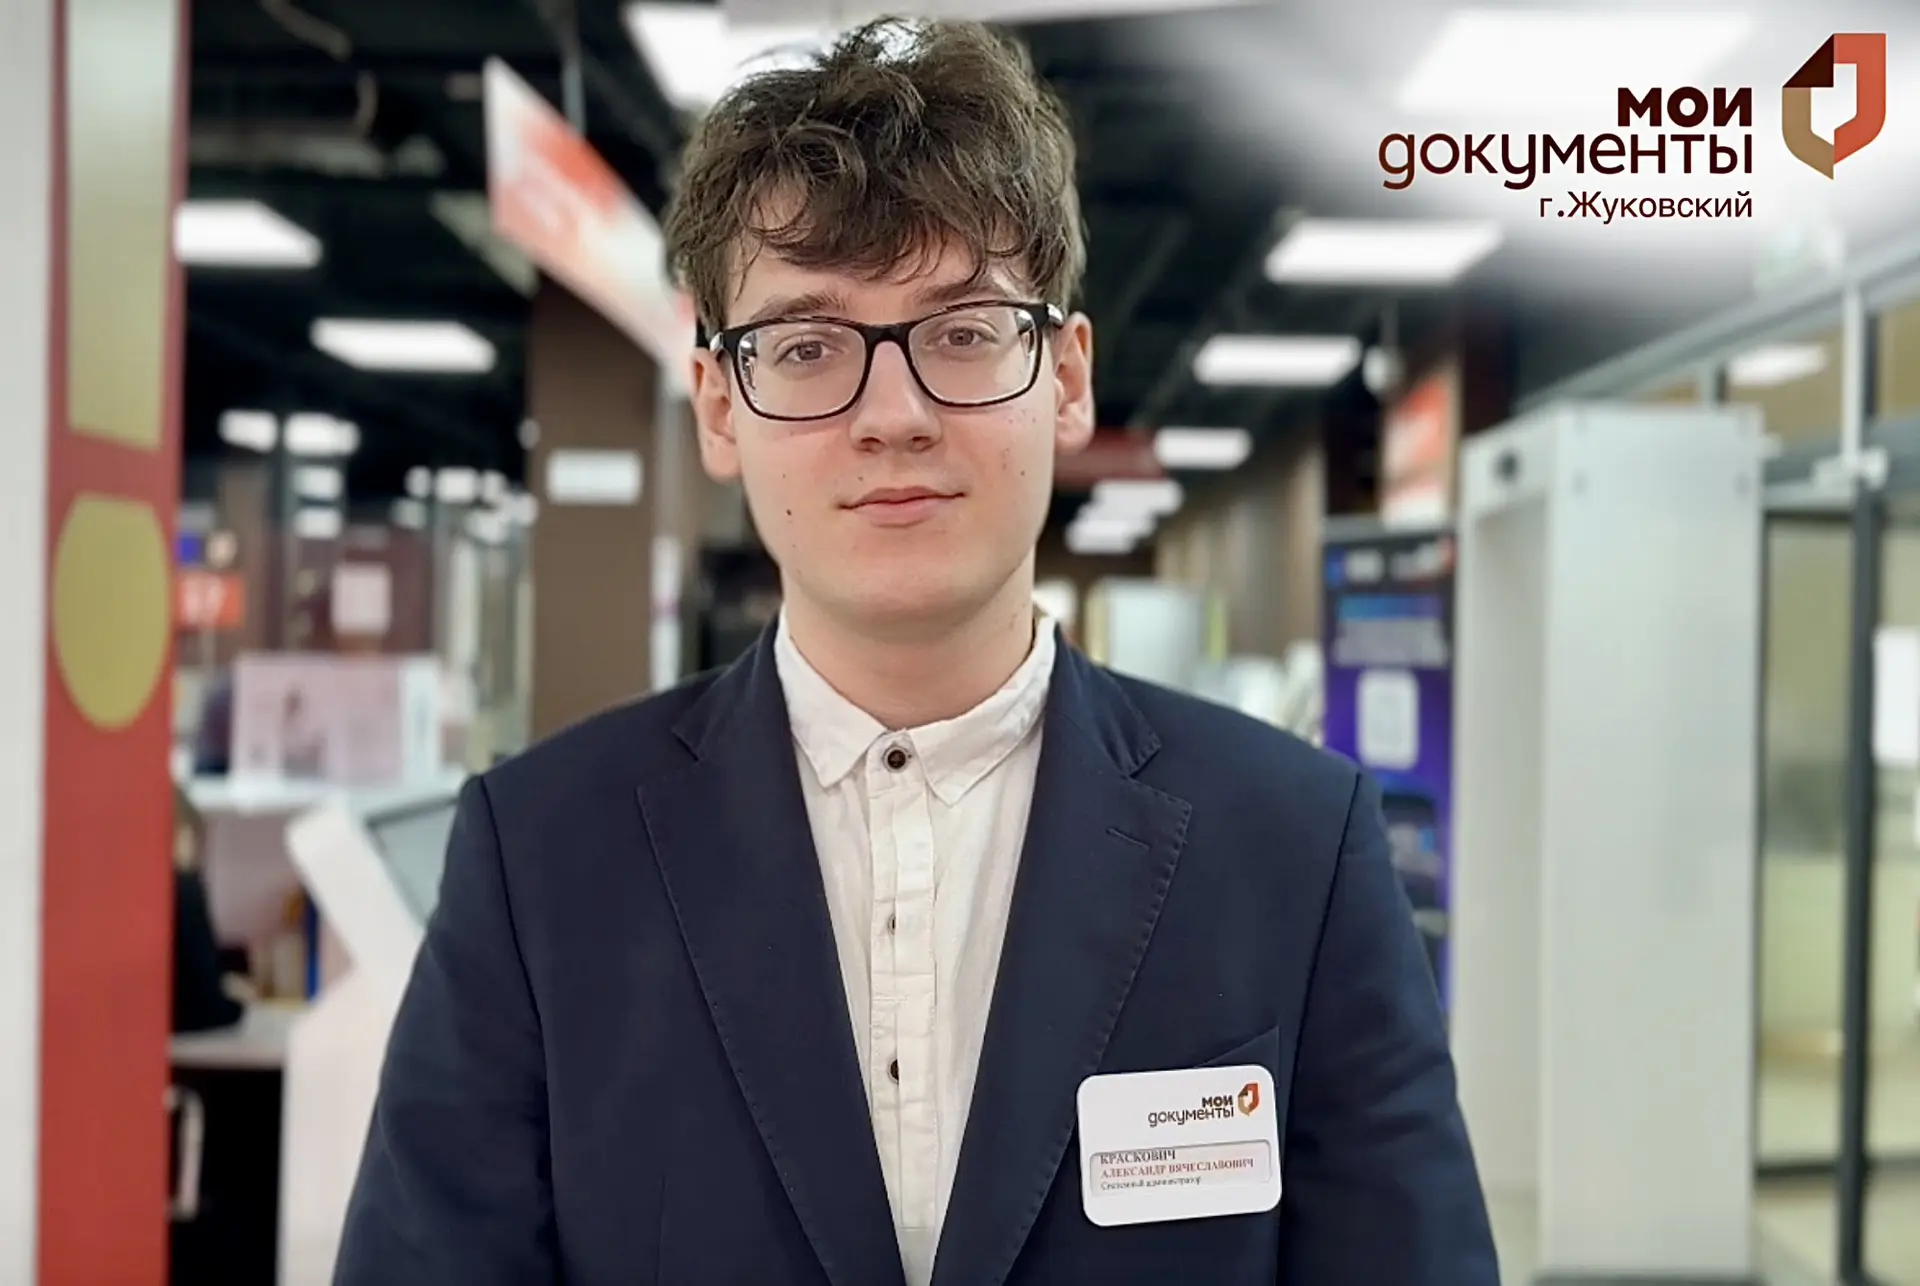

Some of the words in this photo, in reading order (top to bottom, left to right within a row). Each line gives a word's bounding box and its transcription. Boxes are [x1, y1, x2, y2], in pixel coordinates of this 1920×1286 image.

[1202, 1095, 1233, 1107] мои
[1148, 1107, 1234, 1127] документы
[1100, 1150, 1176, 1165] КРАСКОВИЧ
[1101, 1165, 1166, 1179] АЛЕКСАНДР
[1168, 1158, 1254, 1174] ВЯЧЕСЛАВОВИЧ
